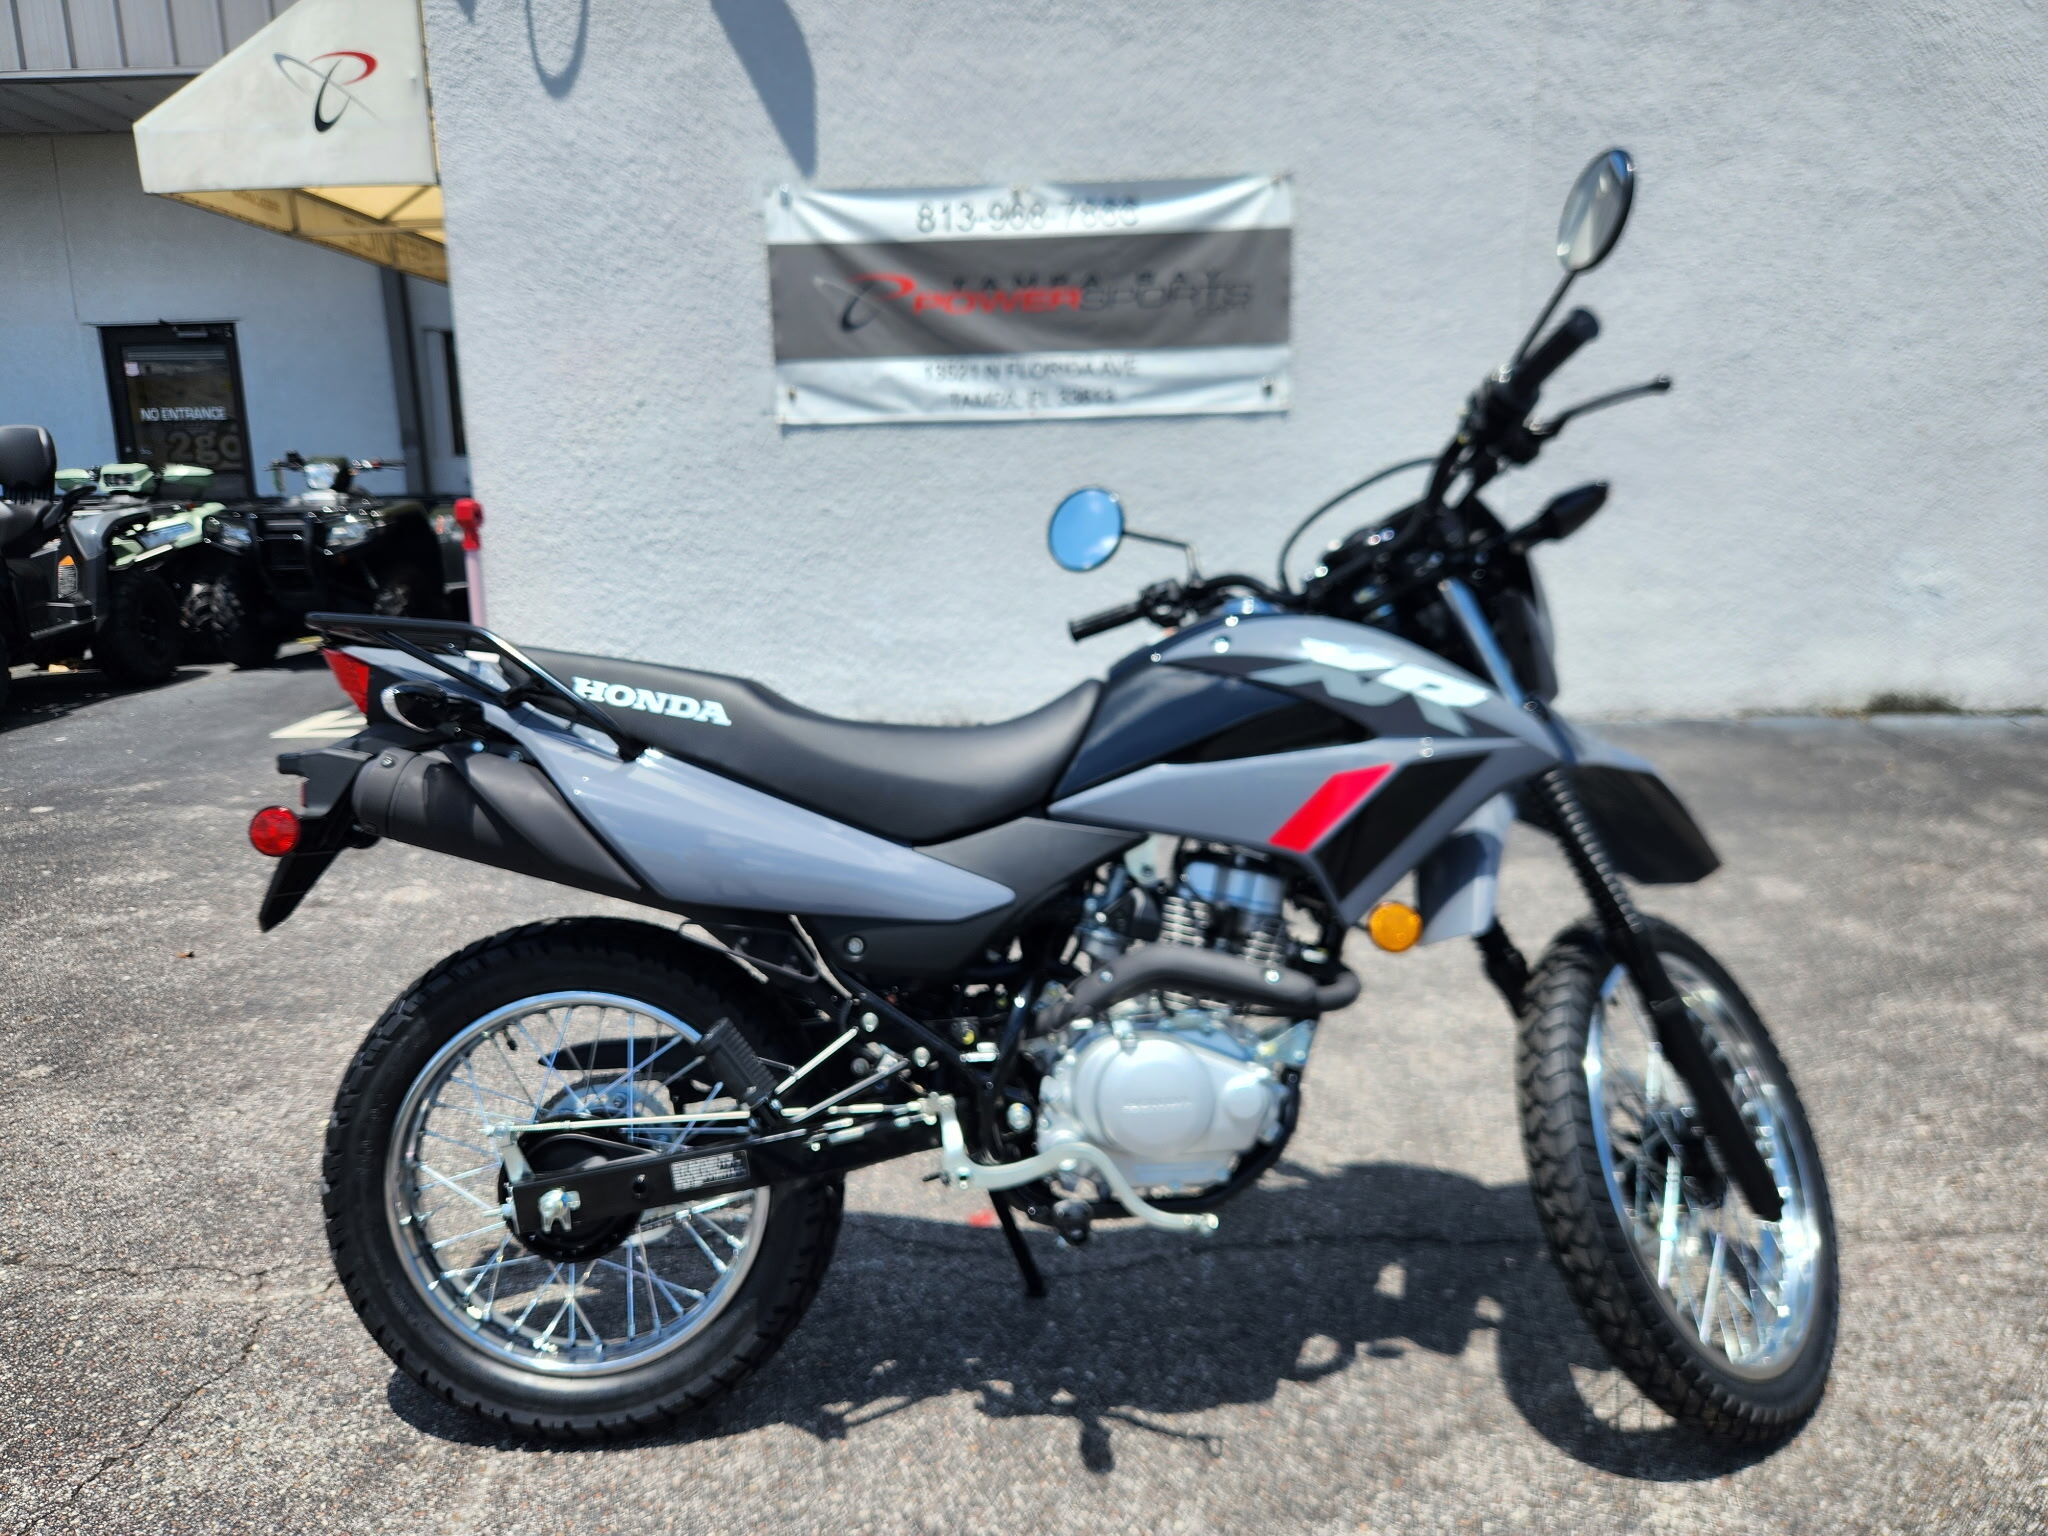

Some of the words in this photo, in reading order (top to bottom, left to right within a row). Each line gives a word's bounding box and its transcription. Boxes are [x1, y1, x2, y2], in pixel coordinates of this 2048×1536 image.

[139, 407, 159, 421] NO
[162, 406, 227, 421] ENTRANCE
[571, 676, 732, 727] HONDA
